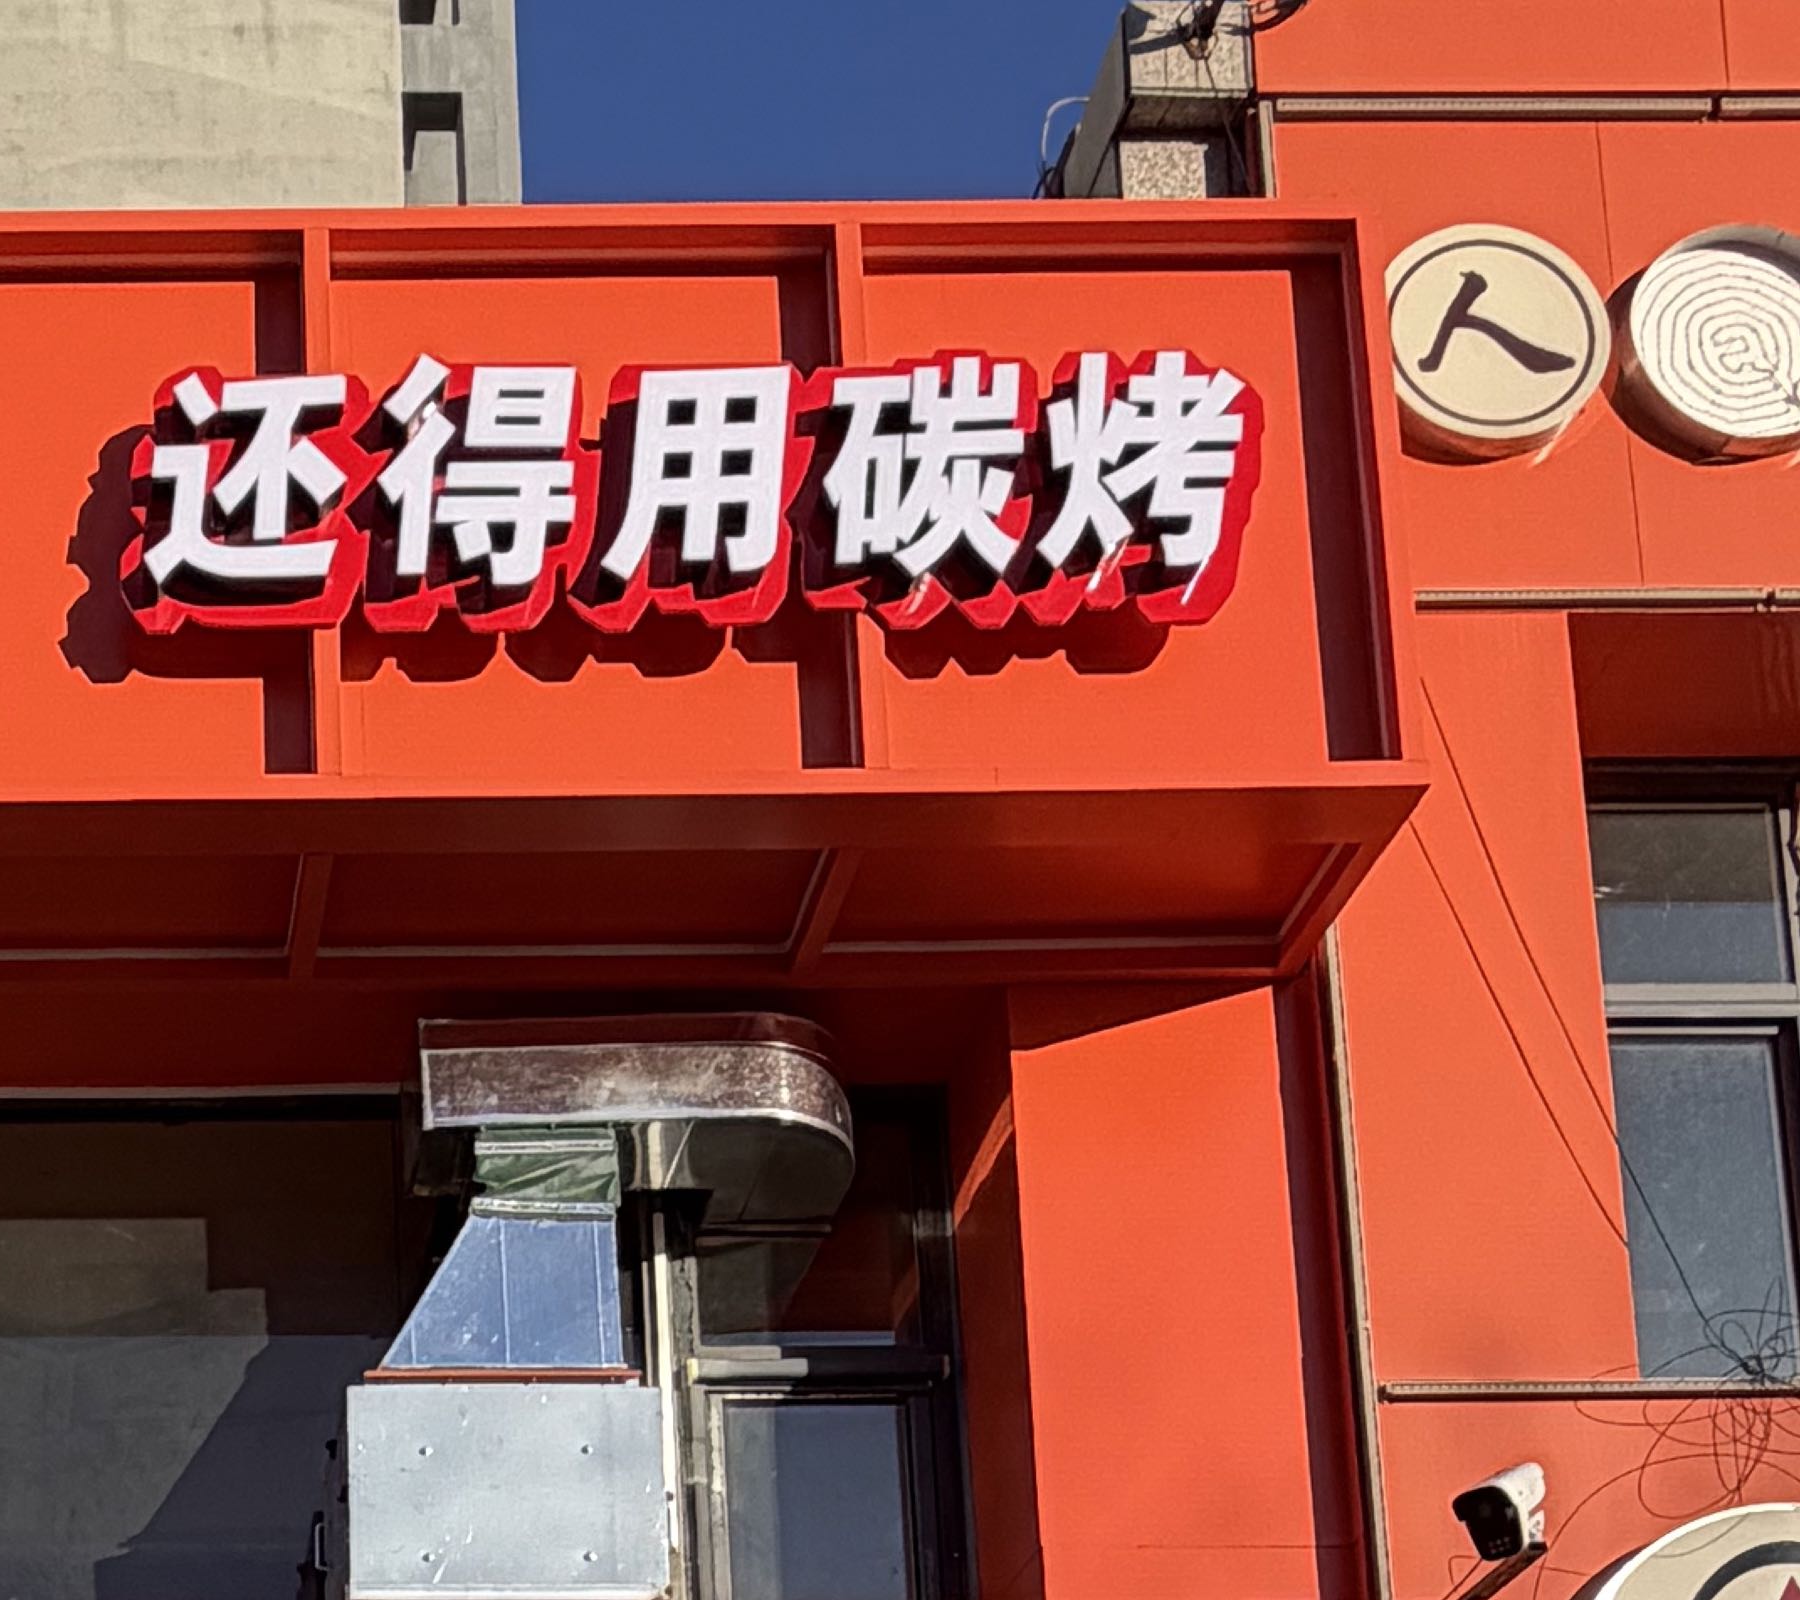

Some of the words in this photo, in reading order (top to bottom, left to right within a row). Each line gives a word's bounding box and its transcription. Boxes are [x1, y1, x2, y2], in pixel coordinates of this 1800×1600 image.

[144, 352, 1247, 586] 还得用碳烤
